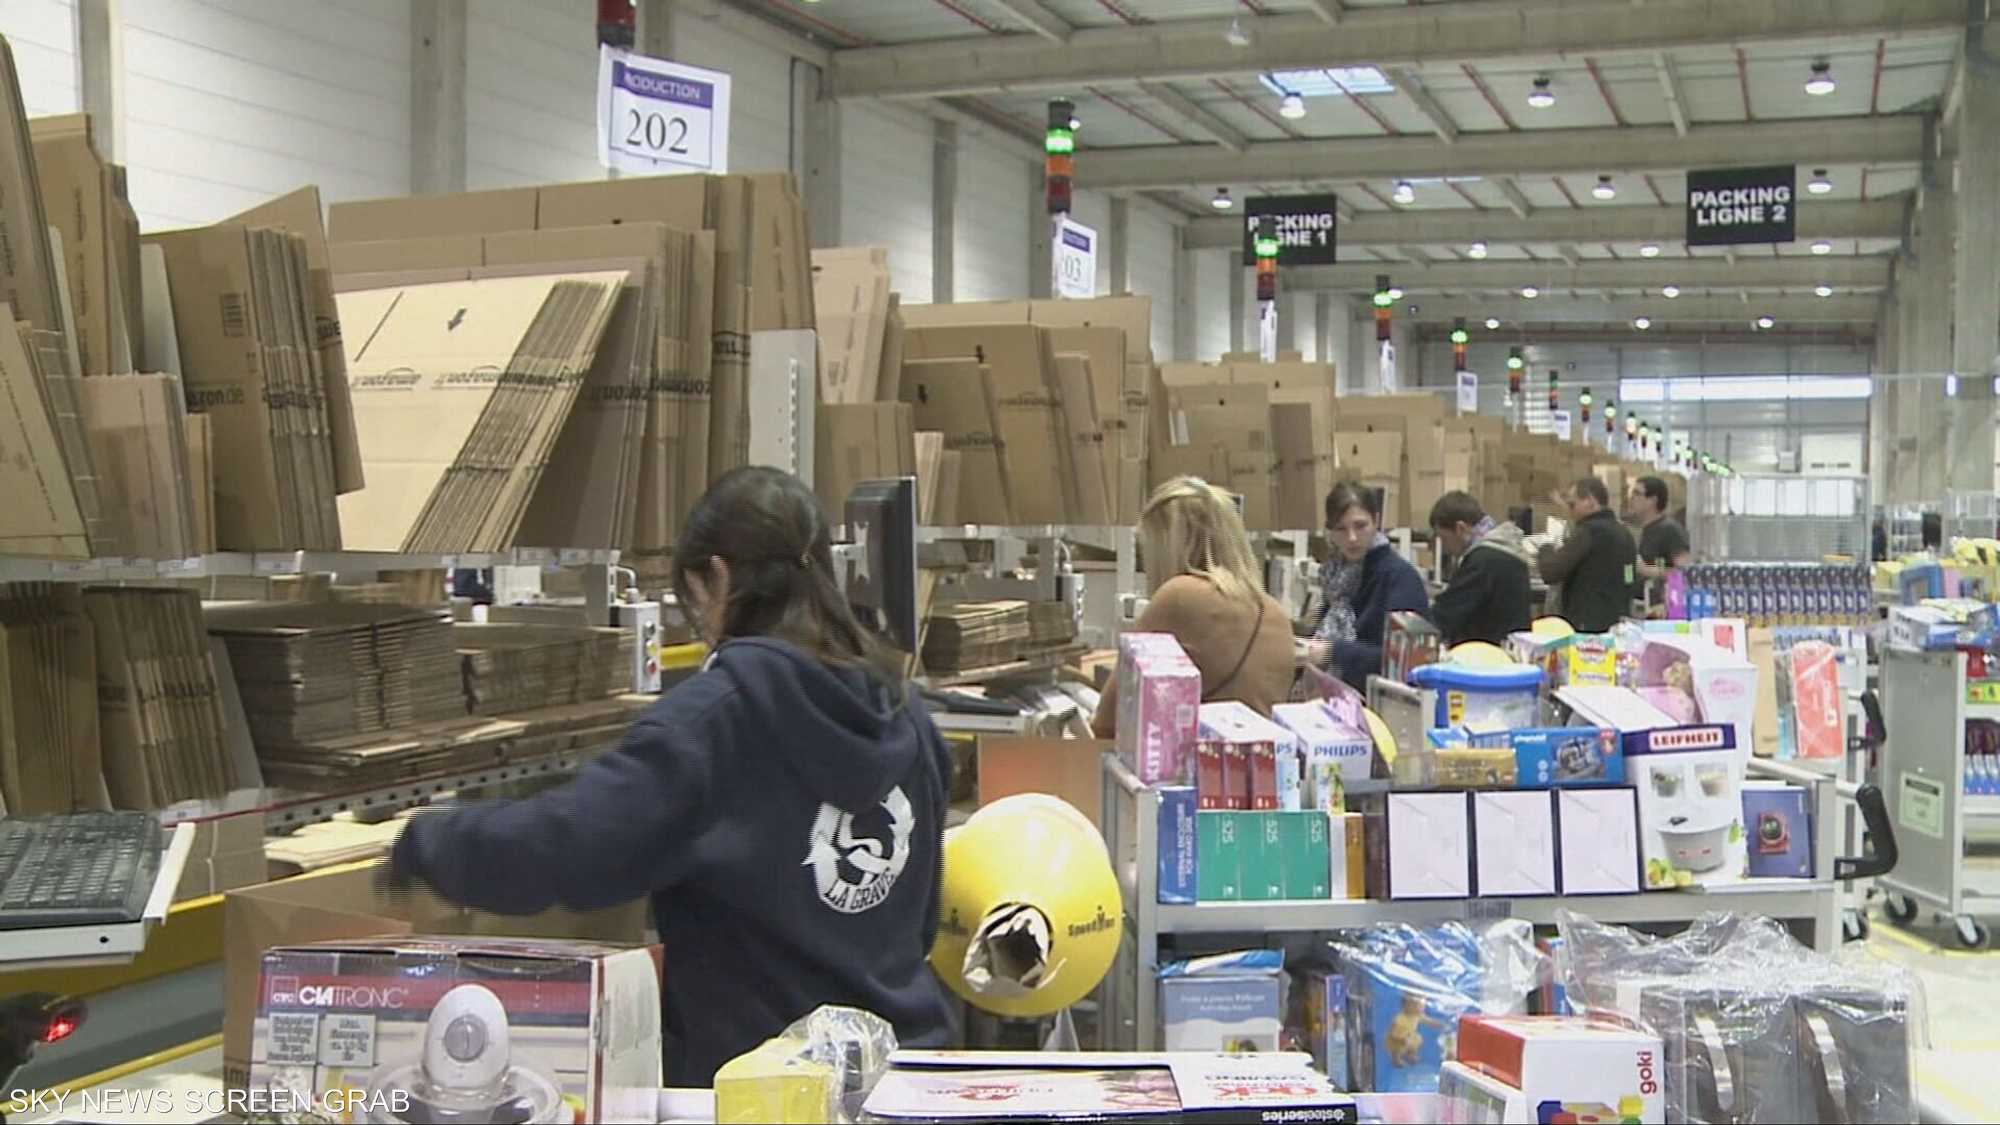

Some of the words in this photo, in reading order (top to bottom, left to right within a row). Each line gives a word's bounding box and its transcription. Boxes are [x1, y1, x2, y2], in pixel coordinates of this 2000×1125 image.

[625, 108, 689, 155] 202
[1690, 186, 1791, 208] PACKING
[1248, 213, 1333, 232] PCKING
[1697, 206, 1764, 226] LIGNE
[1772, 204, 1786, 222] 2
[1317, 230, 1327, 246] 1
[1146, 721, 1162, 780] KITTY
[1314, 744, 1368, 757] PHILIPS
[1654, 732, 1719, 746] LEIFHEIT
[1221, 819, 1235, 844] 525
[1266, 819, 1280, 844] 525
[1311, 819, 1324, 843] 525
[1636, 1051, 1657, 1095] goki
